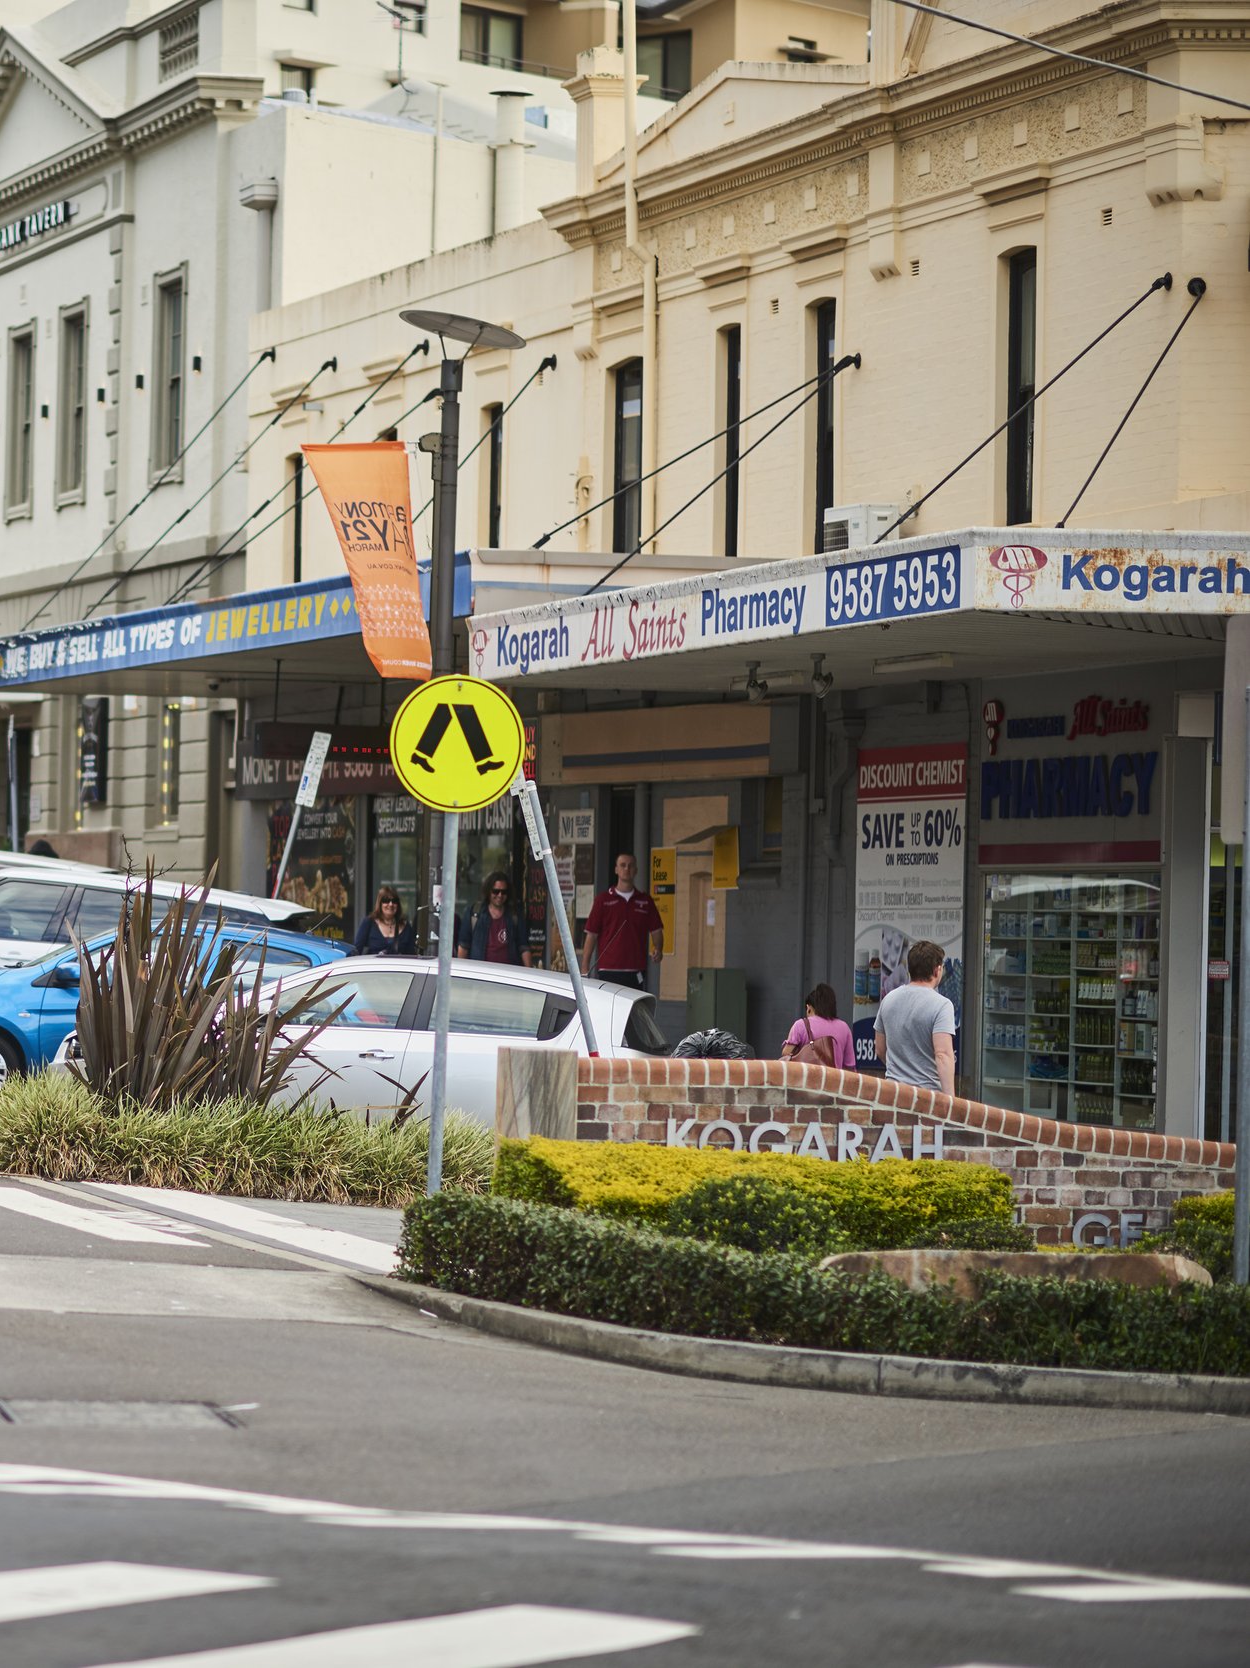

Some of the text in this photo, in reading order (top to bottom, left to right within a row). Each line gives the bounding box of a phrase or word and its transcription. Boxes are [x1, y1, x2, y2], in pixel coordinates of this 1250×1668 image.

[24, 201, 68, 242] TAVERN
[1062, 554, 1250, 602] Kogarah
[497, 551, 956, 676] Kogarah All Saints Pharmacy 9587 5953
[6, 594, 327, 673] WE BUY & SELL ALL TYPES OF JEWELLERY
[525, 726, 536, 742] UY
[525, 744, 537, 761] ND
[242, 756, 280, 785] MONEY
[523, 762, 536, 779] ELL
[859, 759, 965, 789] DISCOUNT CHEMIST
[981, 752, 1158, 820] PHARMACY
[485, 794, 513, 832] CASH
[862, 807, 962, 849] SAVE UP TO 60%
[653, 856, 661, 868] For
[653, 869, 667, 881] Lease
[886, 853, 939, 867] ON PRESCRIPTIONS
[666, 1118, 943, 1163] KOGARAH
